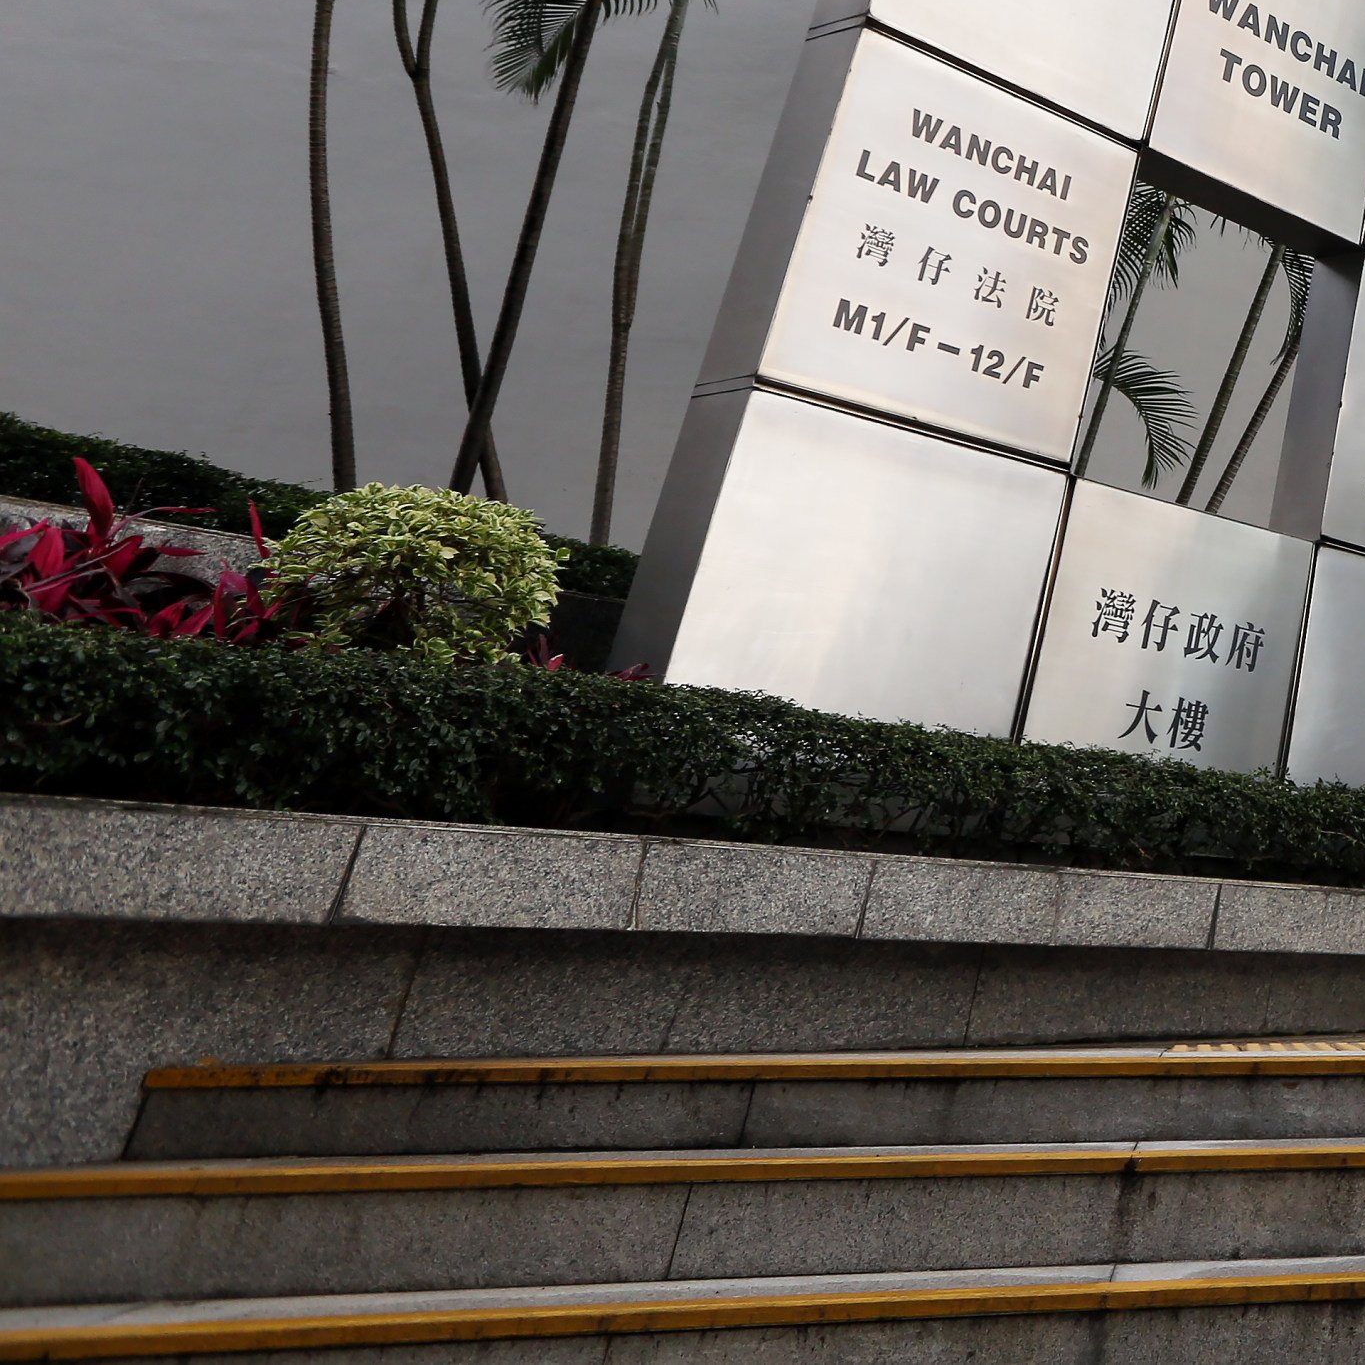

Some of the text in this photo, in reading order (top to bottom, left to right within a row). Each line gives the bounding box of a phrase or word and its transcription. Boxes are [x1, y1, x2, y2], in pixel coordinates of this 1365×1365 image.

[1219, 47, 1343, 140] TOWER
[911, 107, 1072, 201] WANCHAI
[855, 149, 1089, 265] LAW COURTS
[855, 222, 1060, 327] 灣仔法院
[1091, 587, 1265, 673] 灣仔政府
[1117, 689, 1209, 752] 大樓
